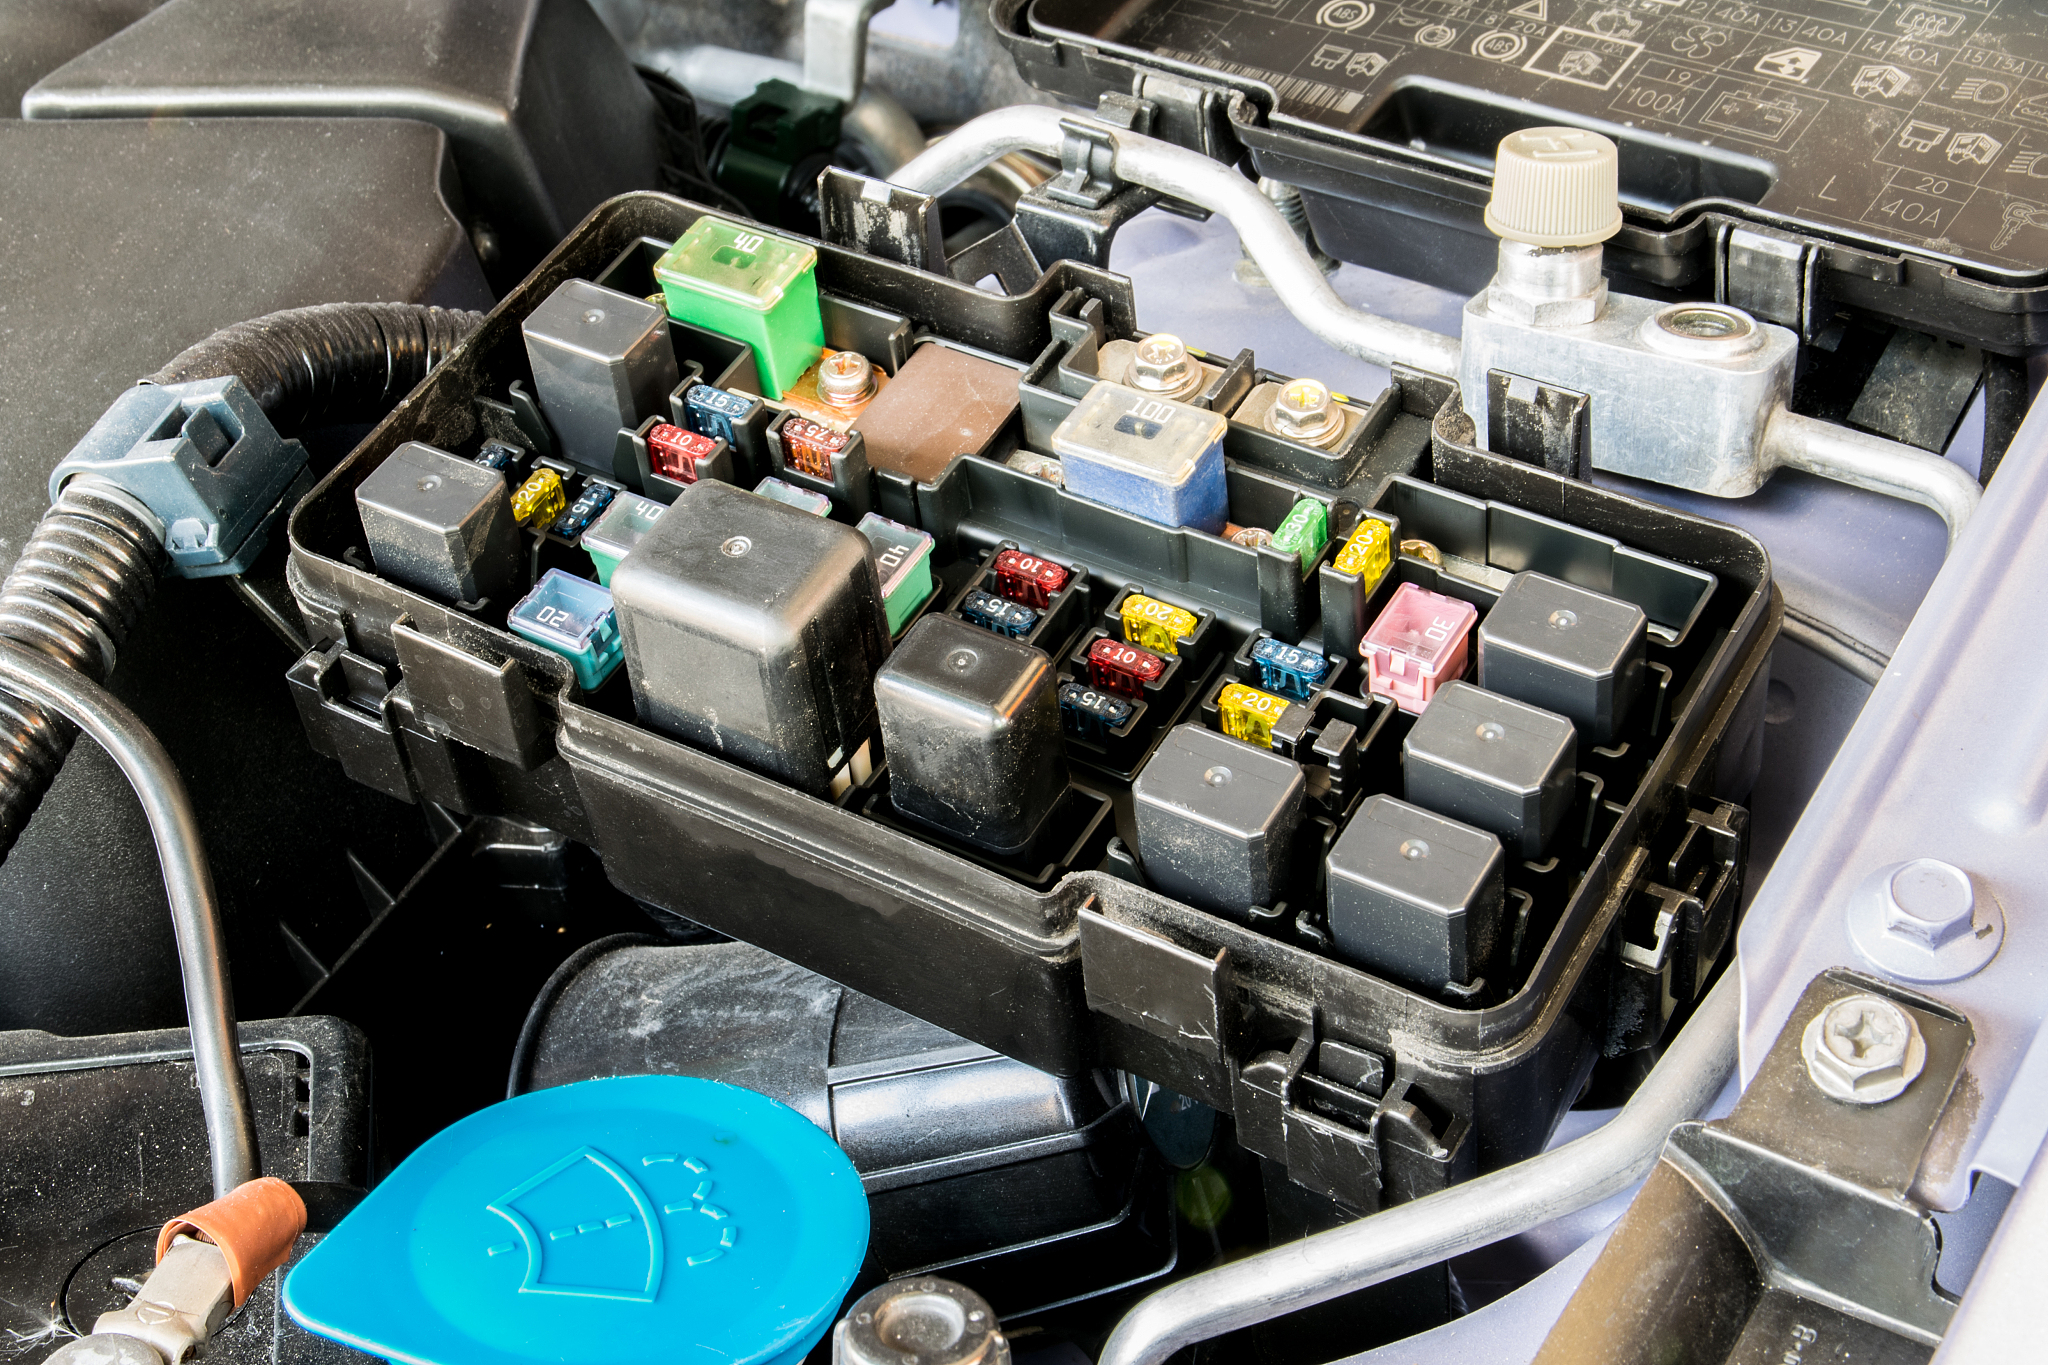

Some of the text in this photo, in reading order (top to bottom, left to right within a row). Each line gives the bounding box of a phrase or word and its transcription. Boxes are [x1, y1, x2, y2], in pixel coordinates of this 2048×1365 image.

[1332, 6, 1358, 21] ABS
[1484, 14, 1498, 25] 8
[1715, 6, 1761, 27] 40A
[1509, 20, 1548, 38] 20A
[1772, 17, 1799, 33] 13
[1801, 25, 1848, 45] 40A
[1485, 37, 1514, 53] ABS
[1862, 36, 1885, 54] 14
[1893, 46, 1940, 66] 40A
[1963, 49, 1986, 63] 15
[1993, 56, 2026, 74] 15A
[1665, 68, 1692, 84] 19
[1627, 86, 1686, 116] 100A
[1818, 175, 1837, 202] L
[1915, 176, 1949, 195] 20
[1880, 199, 1942, 229] 40A
[733, 231, 765, 253] 40
[704, 392, 731, 408] 15
[1125, 396, 1177, 424] 100
[669, 431, 693, 446] 10
[517, 481, 542, 502] 20
[571, 497, 595, 515] 15
[635, 501, 665, 521] 40
[1285, 514, 1310, 532] 30
[1348, 534, 1374, 556] 20
[879, 544, 910, 568] 40
[1019, 557, 1043, 573] 10
[985, 598, 1012, 616] 15
[1144, 602, 1174, 621] 20
[1424, 615, 1456, 642] 30
[1112, 647, 1137, 664] 10
[1276, 646, 1302, 664] 15
[1080, 691, 1107, 710] 15
[1242, 692, 1272, 711] 20
